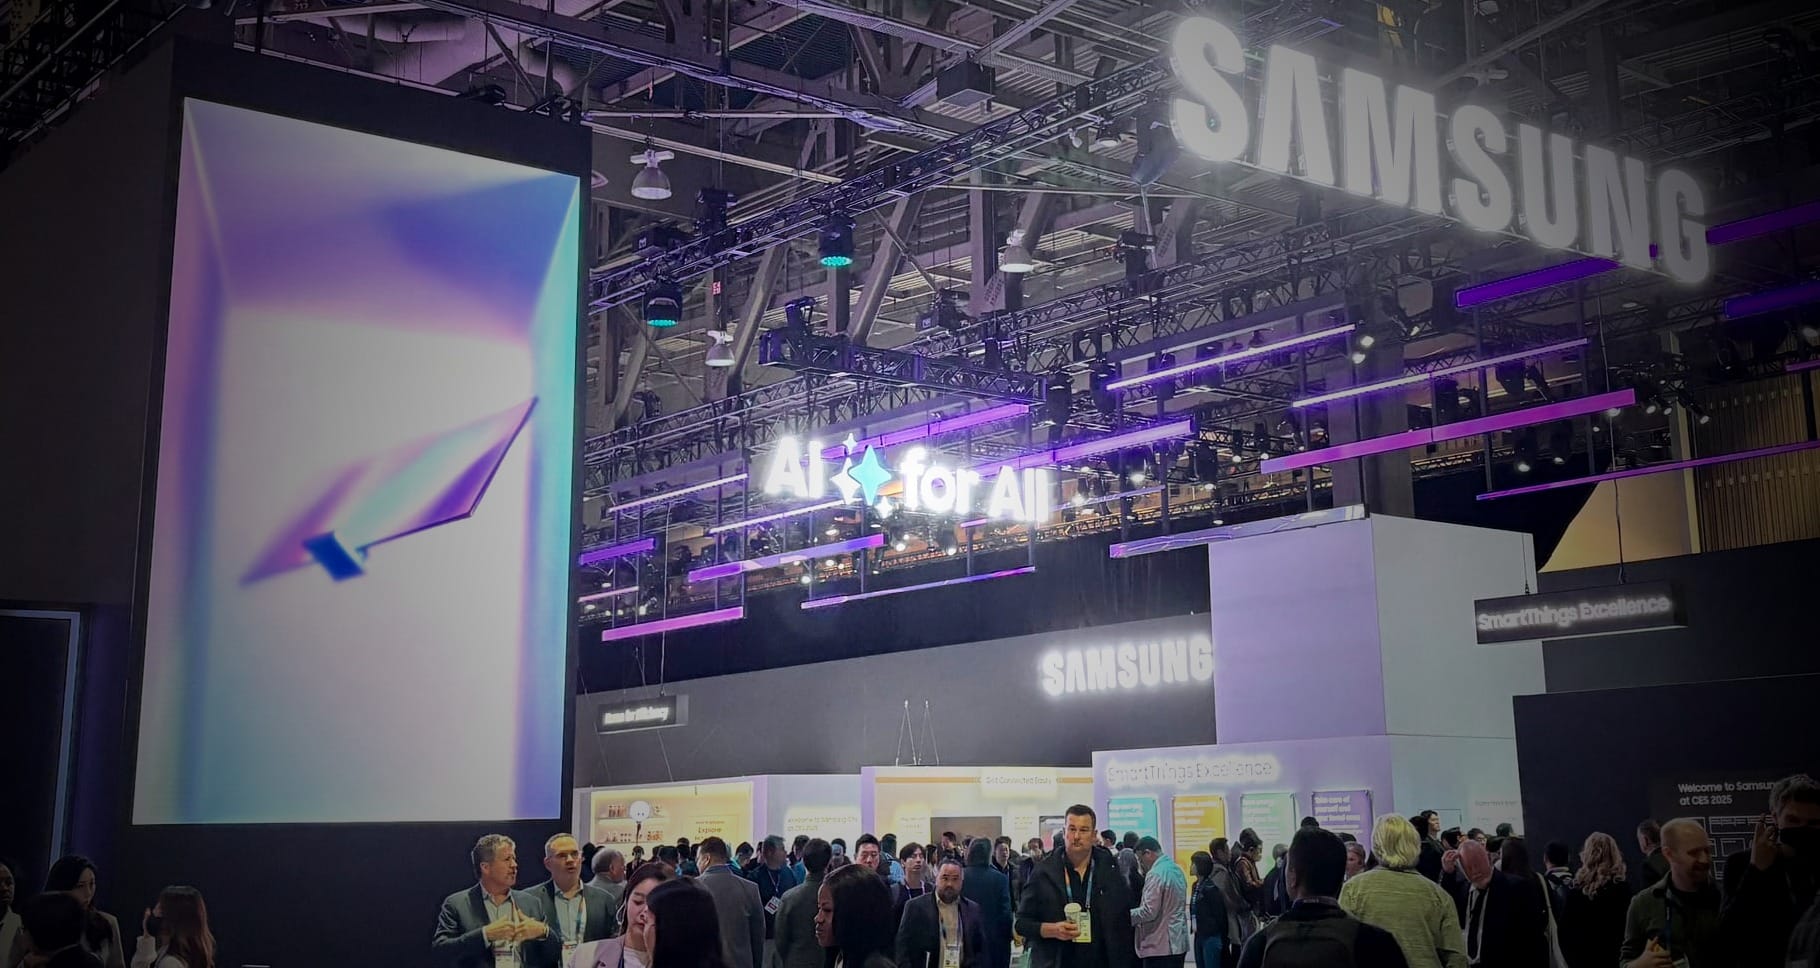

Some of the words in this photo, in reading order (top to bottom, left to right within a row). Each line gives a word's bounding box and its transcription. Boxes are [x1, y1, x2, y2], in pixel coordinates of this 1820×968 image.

[1170, 15, 1711, 284] SAMSUNG
[900, 446, 980, 514] for
[988, 464, 1051, 523] All
[1477, 605, 1578, 630] SmartThings
[1579, 596, 1671, 620] Excellence
[1041, 634, 1214, 697] SAMSUNG
[1107, 761, 1194, 784] SmartThings
[1196, 759, 1273, 779] Excellence
[1677, 783, 1723, 793] Welcome
[1724, 782, 1735, 791] to
[1736, 781, 1777, 791] Samsun
[1680, 796, 1690, 806] at
[1692, 795, 1710, 805] CES
[1711, 795, 1733, 805] 2025
